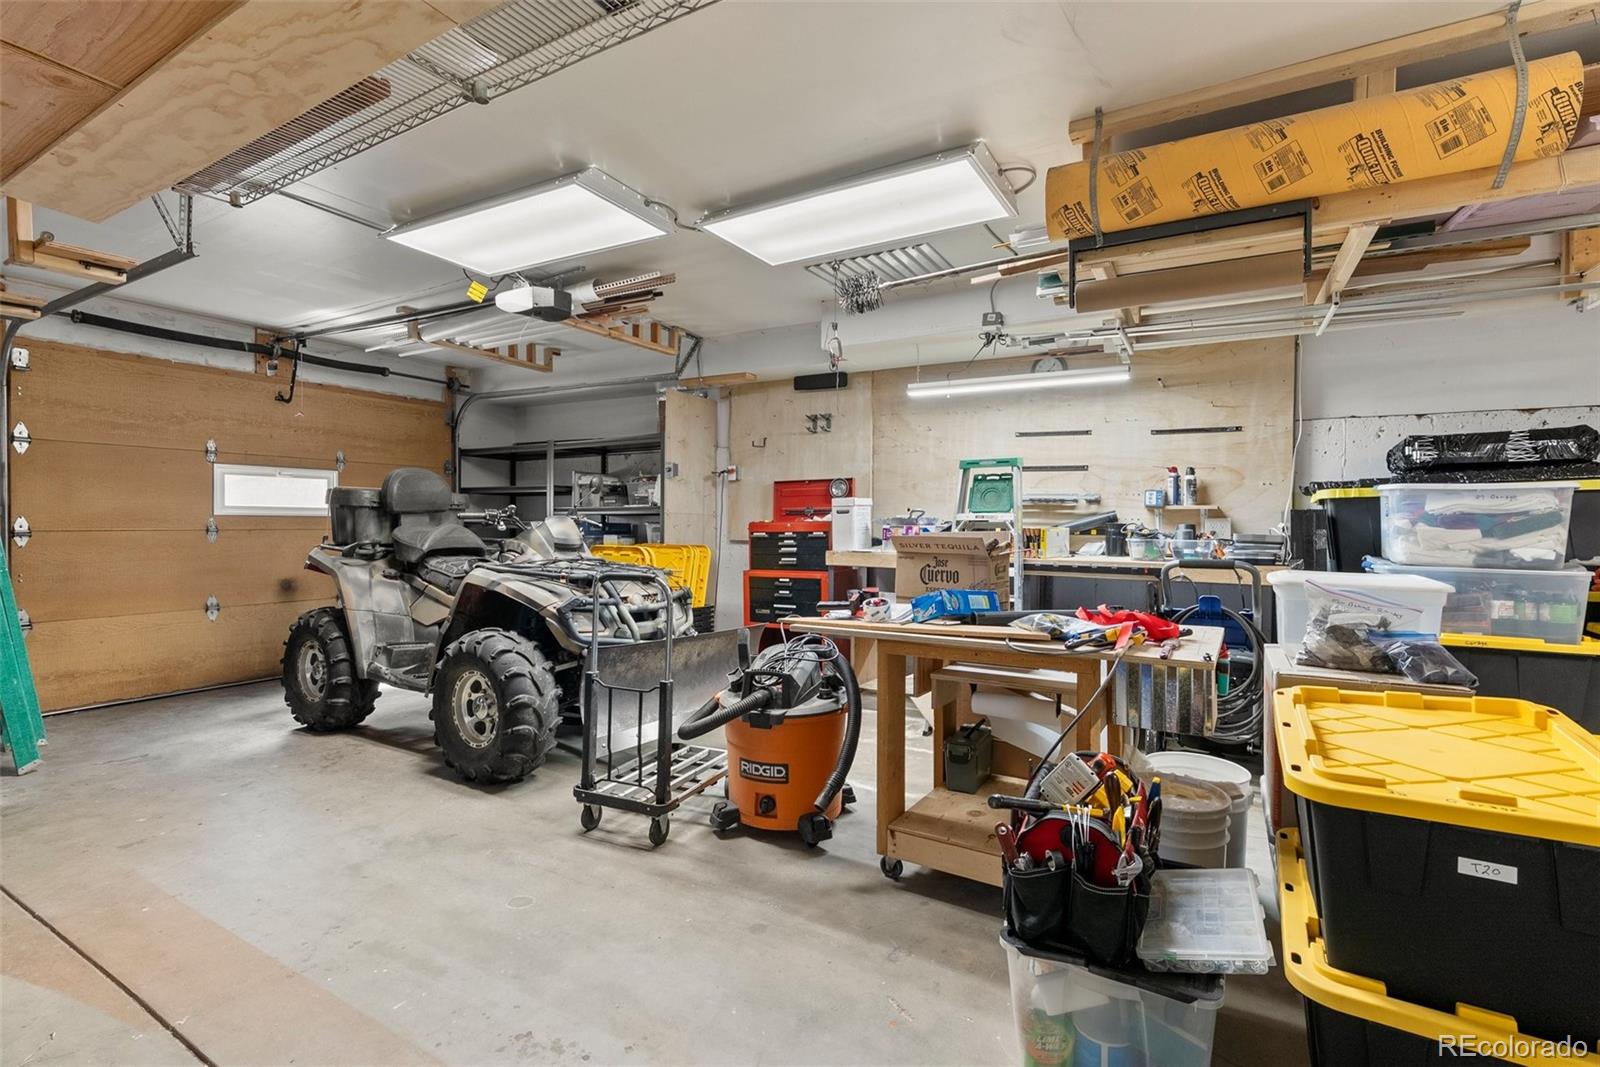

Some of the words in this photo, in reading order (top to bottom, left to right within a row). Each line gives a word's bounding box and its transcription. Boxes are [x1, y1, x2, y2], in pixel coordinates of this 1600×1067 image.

[934, 543, 980, 551] TEQUILA
[920, 563, 960, 585] Cuervo
[741, 760, 786, 777] RIDGID
[1470, 863, 1501, 876] T20
